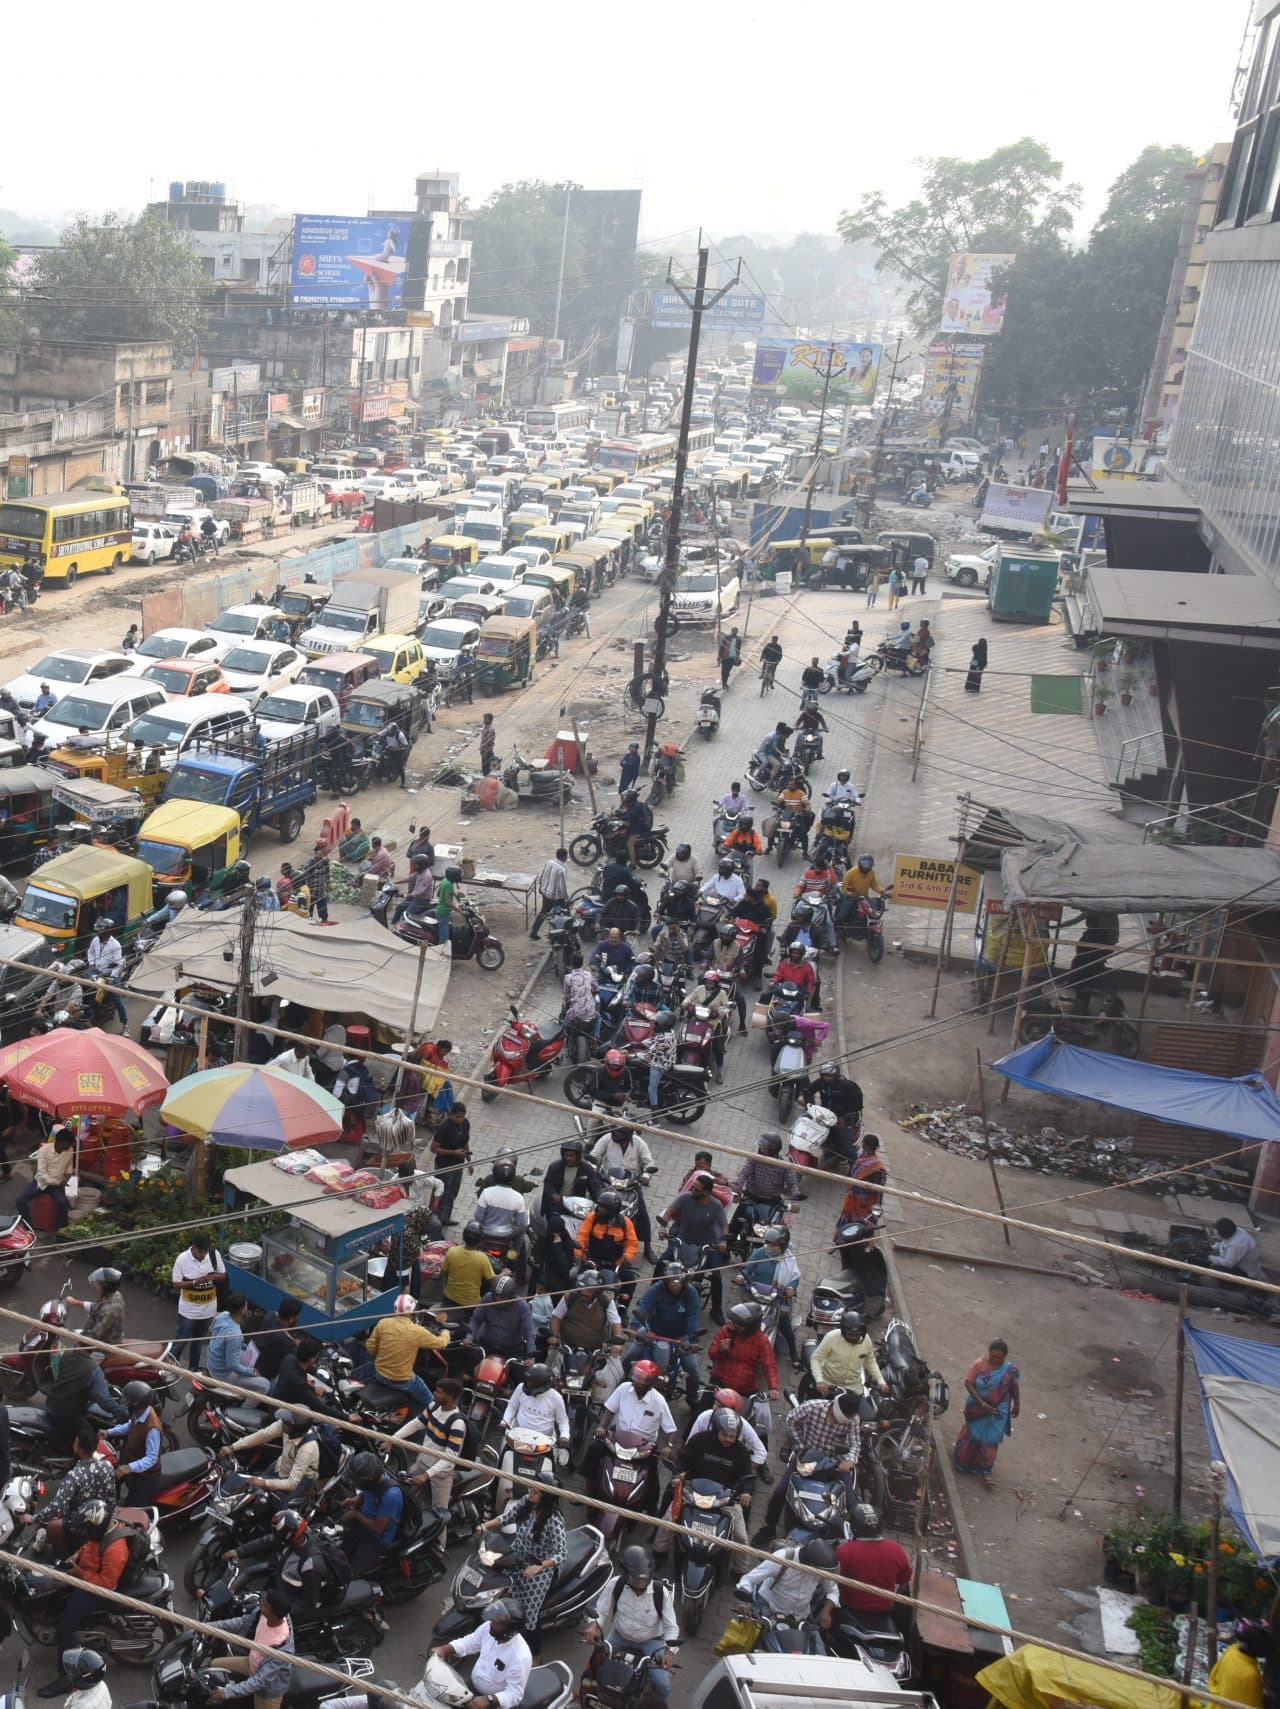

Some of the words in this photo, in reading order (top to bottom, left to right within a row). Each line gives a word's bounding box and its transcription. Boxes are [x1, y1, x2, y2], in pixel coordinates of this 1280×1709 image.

[731, 299, 757, 308] GATE
[919, 861, 955, 874] BABA
[901, 869, 973, 886] FURNITURE
[898, 880, 915, 889] 3rd
[925, 884, 942, 893] 4th
